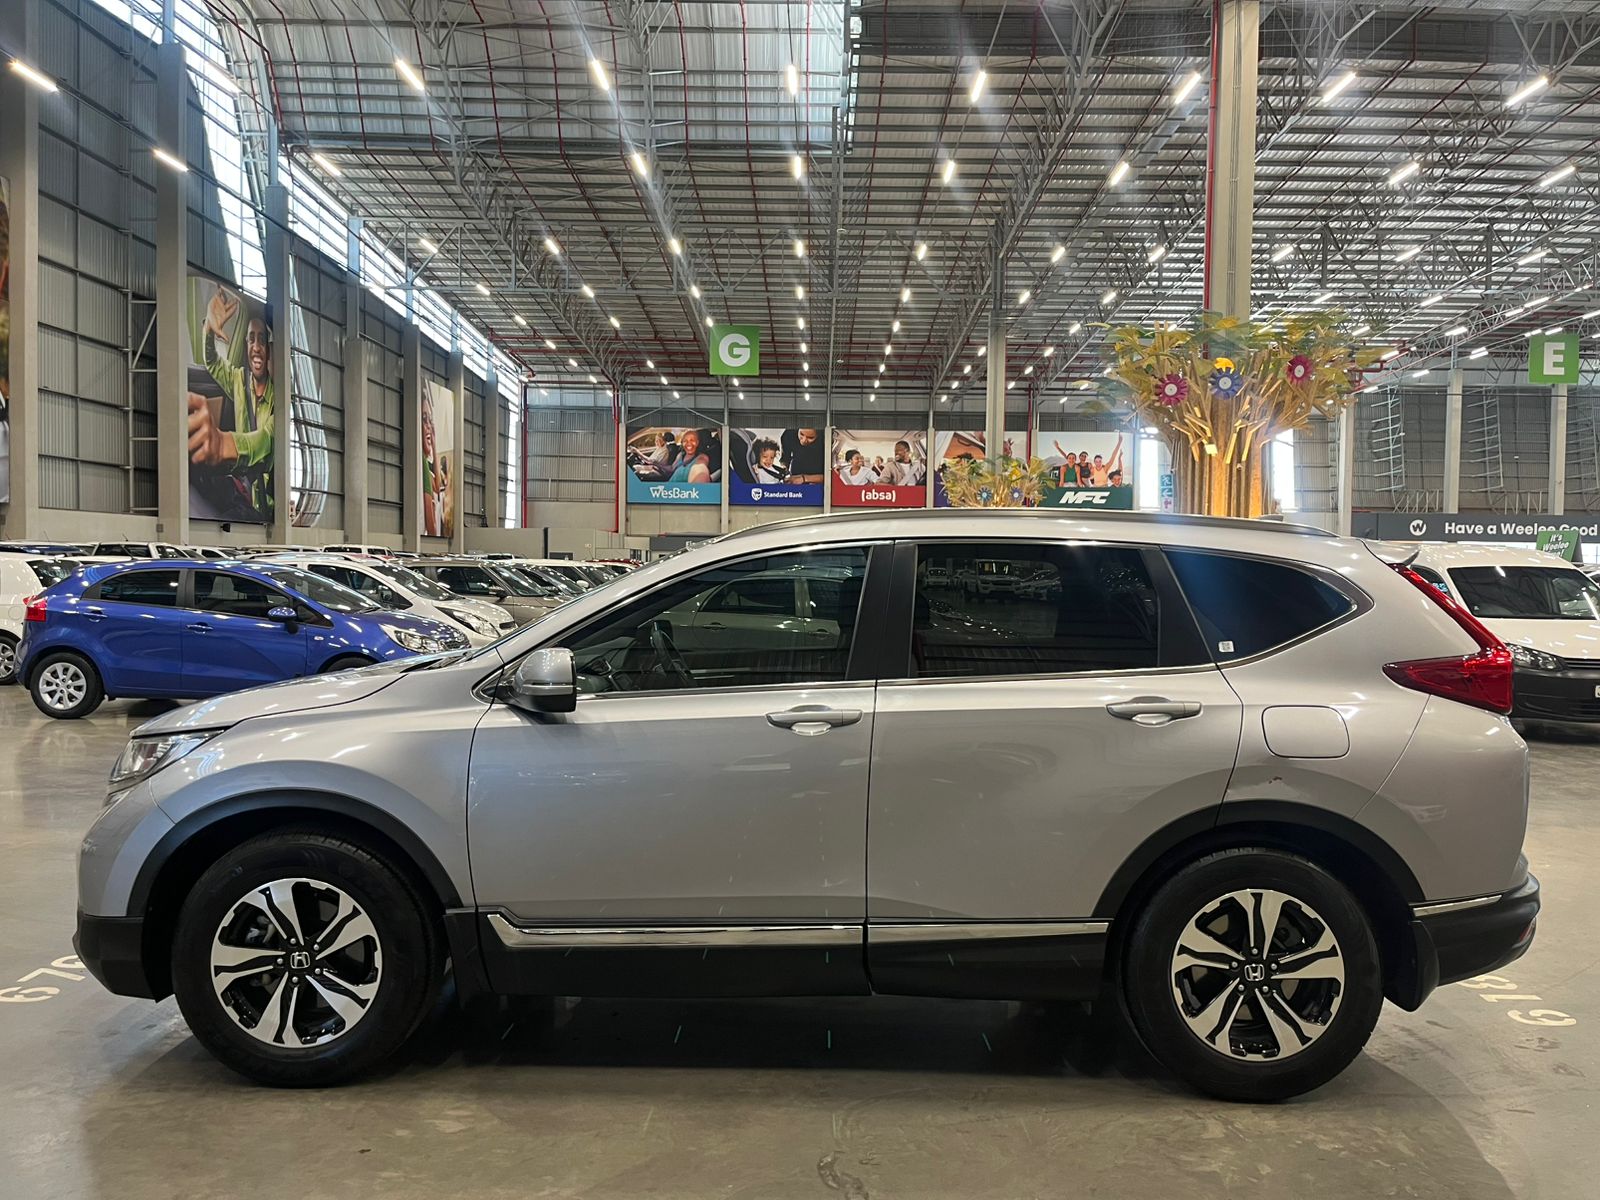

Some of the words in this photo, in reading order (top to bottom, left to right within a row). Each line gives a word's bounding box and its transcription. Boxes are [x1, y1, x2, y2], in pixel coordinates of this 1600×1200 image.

[718, 333, 751, 368] G
[1543, 342, 1565, 376] E
[649, 485, 699, 499] WesBank
[861, 489, 896, 502] (absa)
[1059, 491, 1110, 504] MFC
[1445, 522, 1484, 534] Have
[1487, 524, 1497, 534] a
[1500, 523, 1556, 535] Weelee
